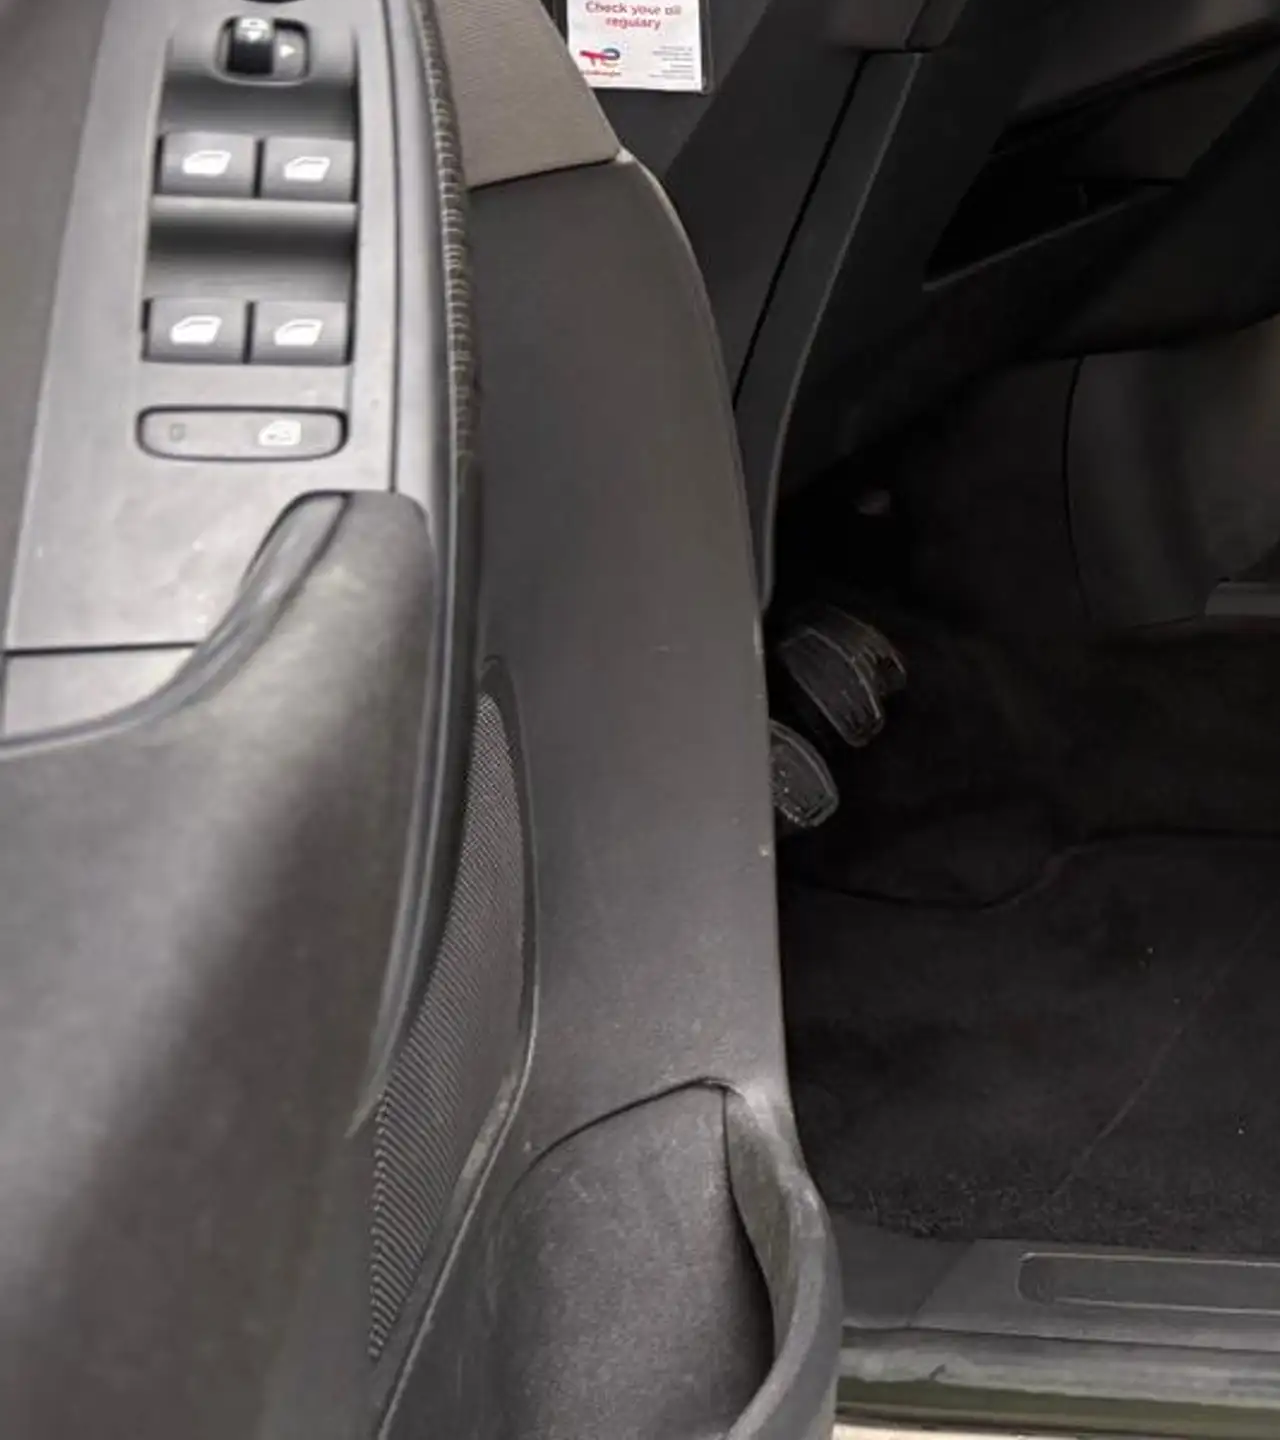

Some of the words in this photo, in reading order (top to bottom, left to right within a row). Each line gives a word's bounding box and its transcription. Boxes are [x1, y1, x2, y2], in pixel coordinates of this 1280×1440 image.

[585, 0, 628, 13] Check
[631, 5, 661, 16] your
[665, 4, 682, 16] oil
[605, 17, 661, 31] regulary
